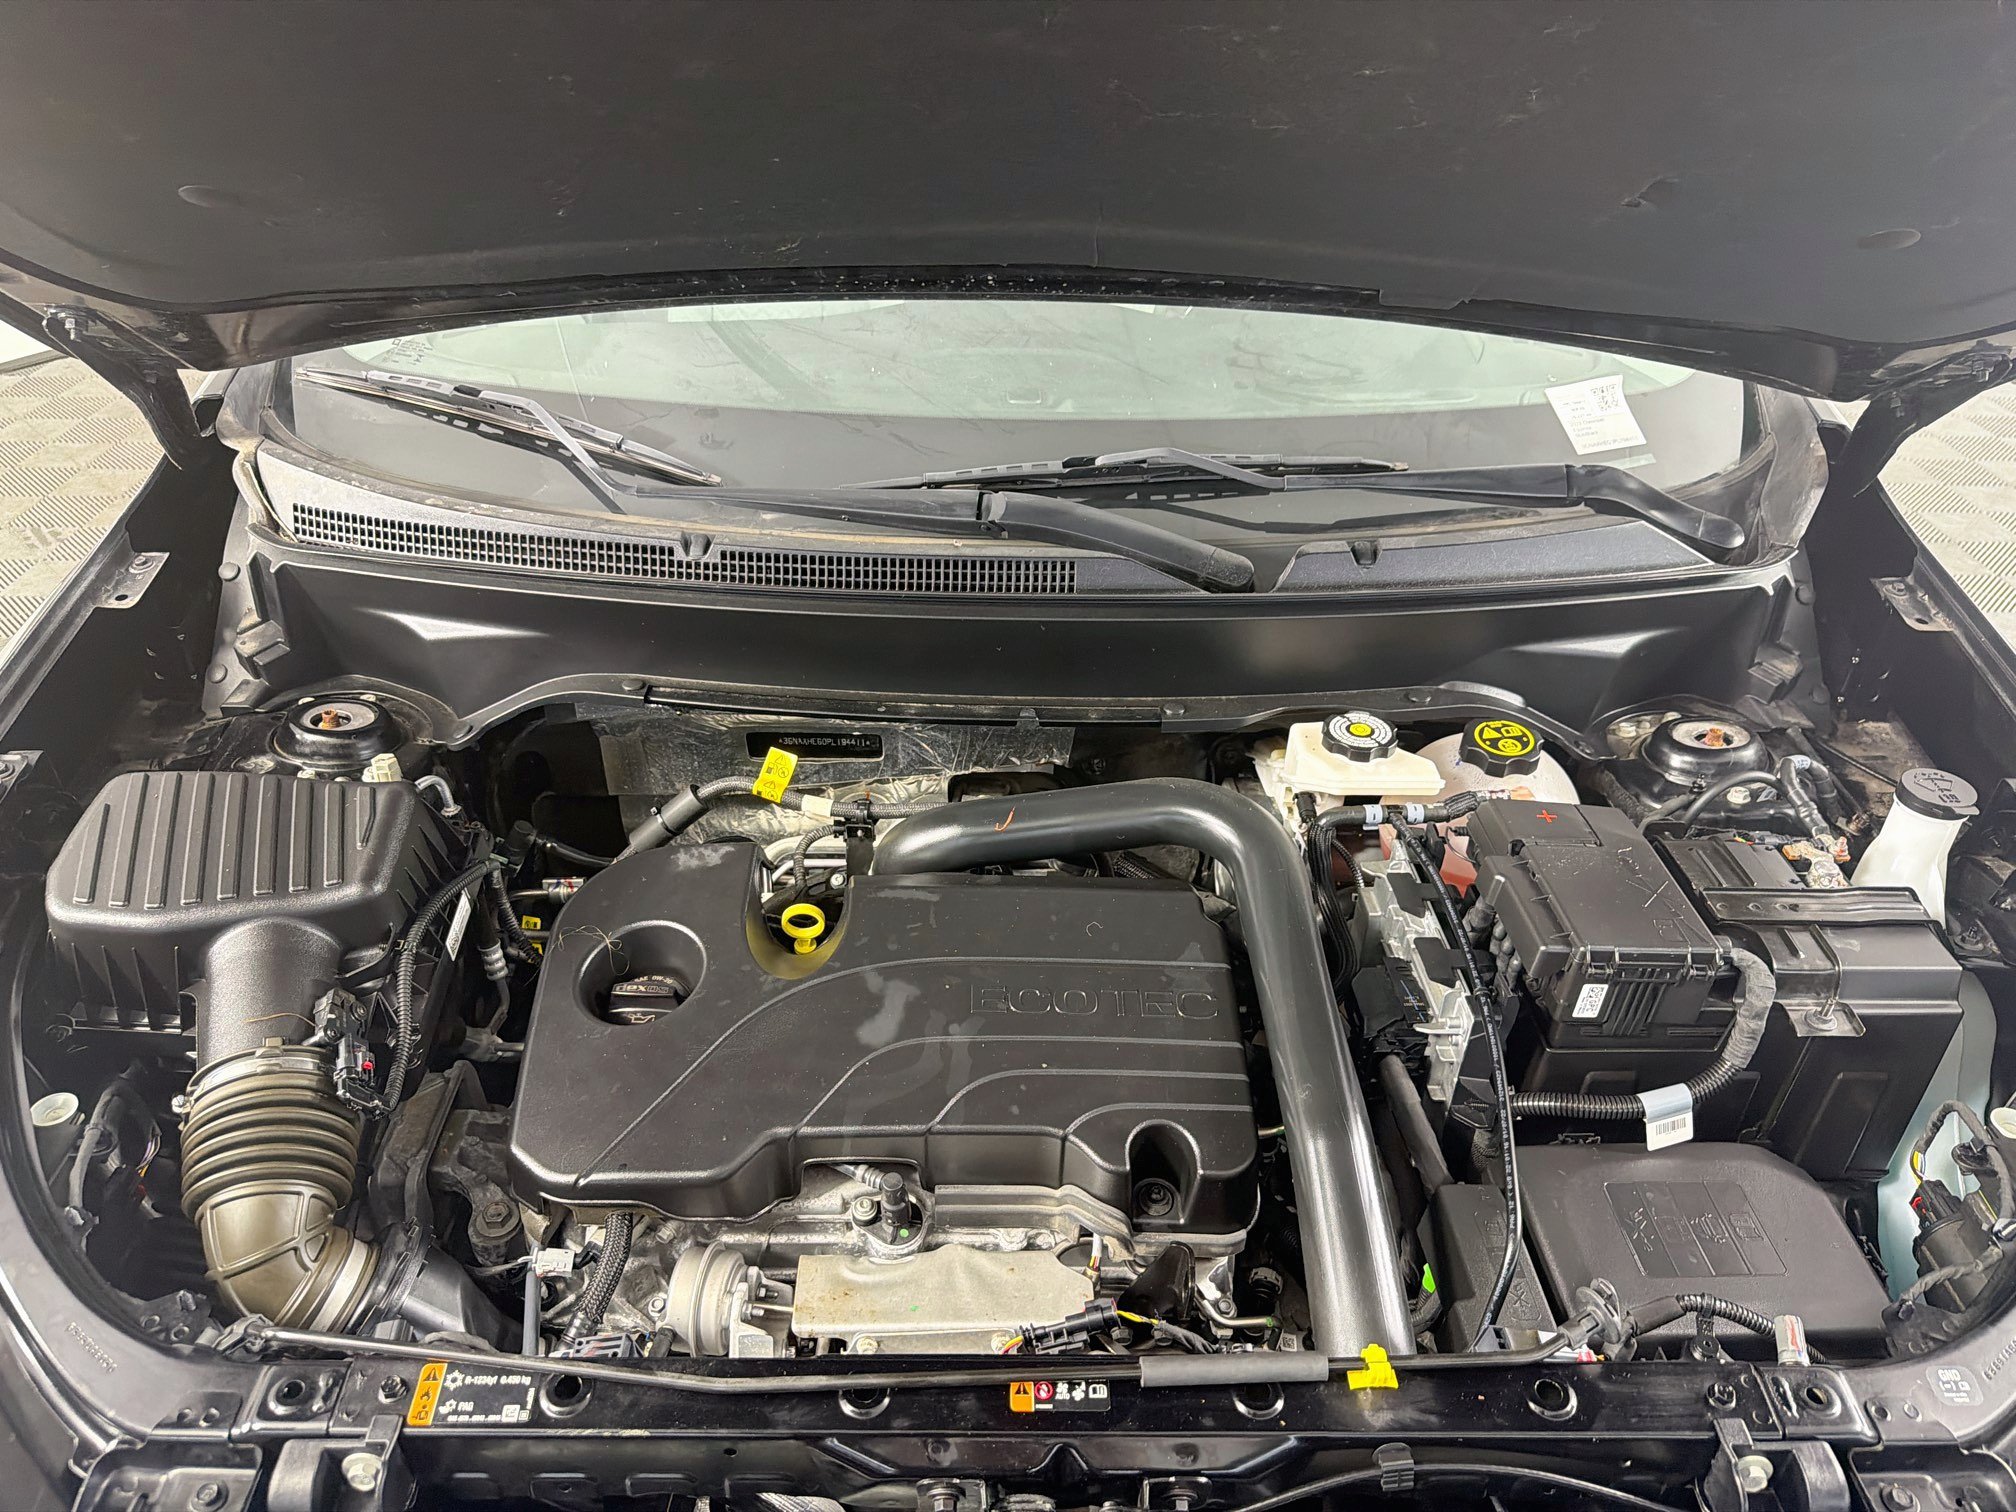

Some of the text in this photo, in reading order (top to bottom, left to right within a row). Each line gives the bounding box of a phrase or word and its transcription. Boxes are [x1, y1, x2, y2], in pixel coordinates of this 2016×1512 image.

[970, 984, 1219, 1020] ECOTEC
[1938, 1369, 1961, 1382] GND
[458, 1401, 474, 1412] PAG
